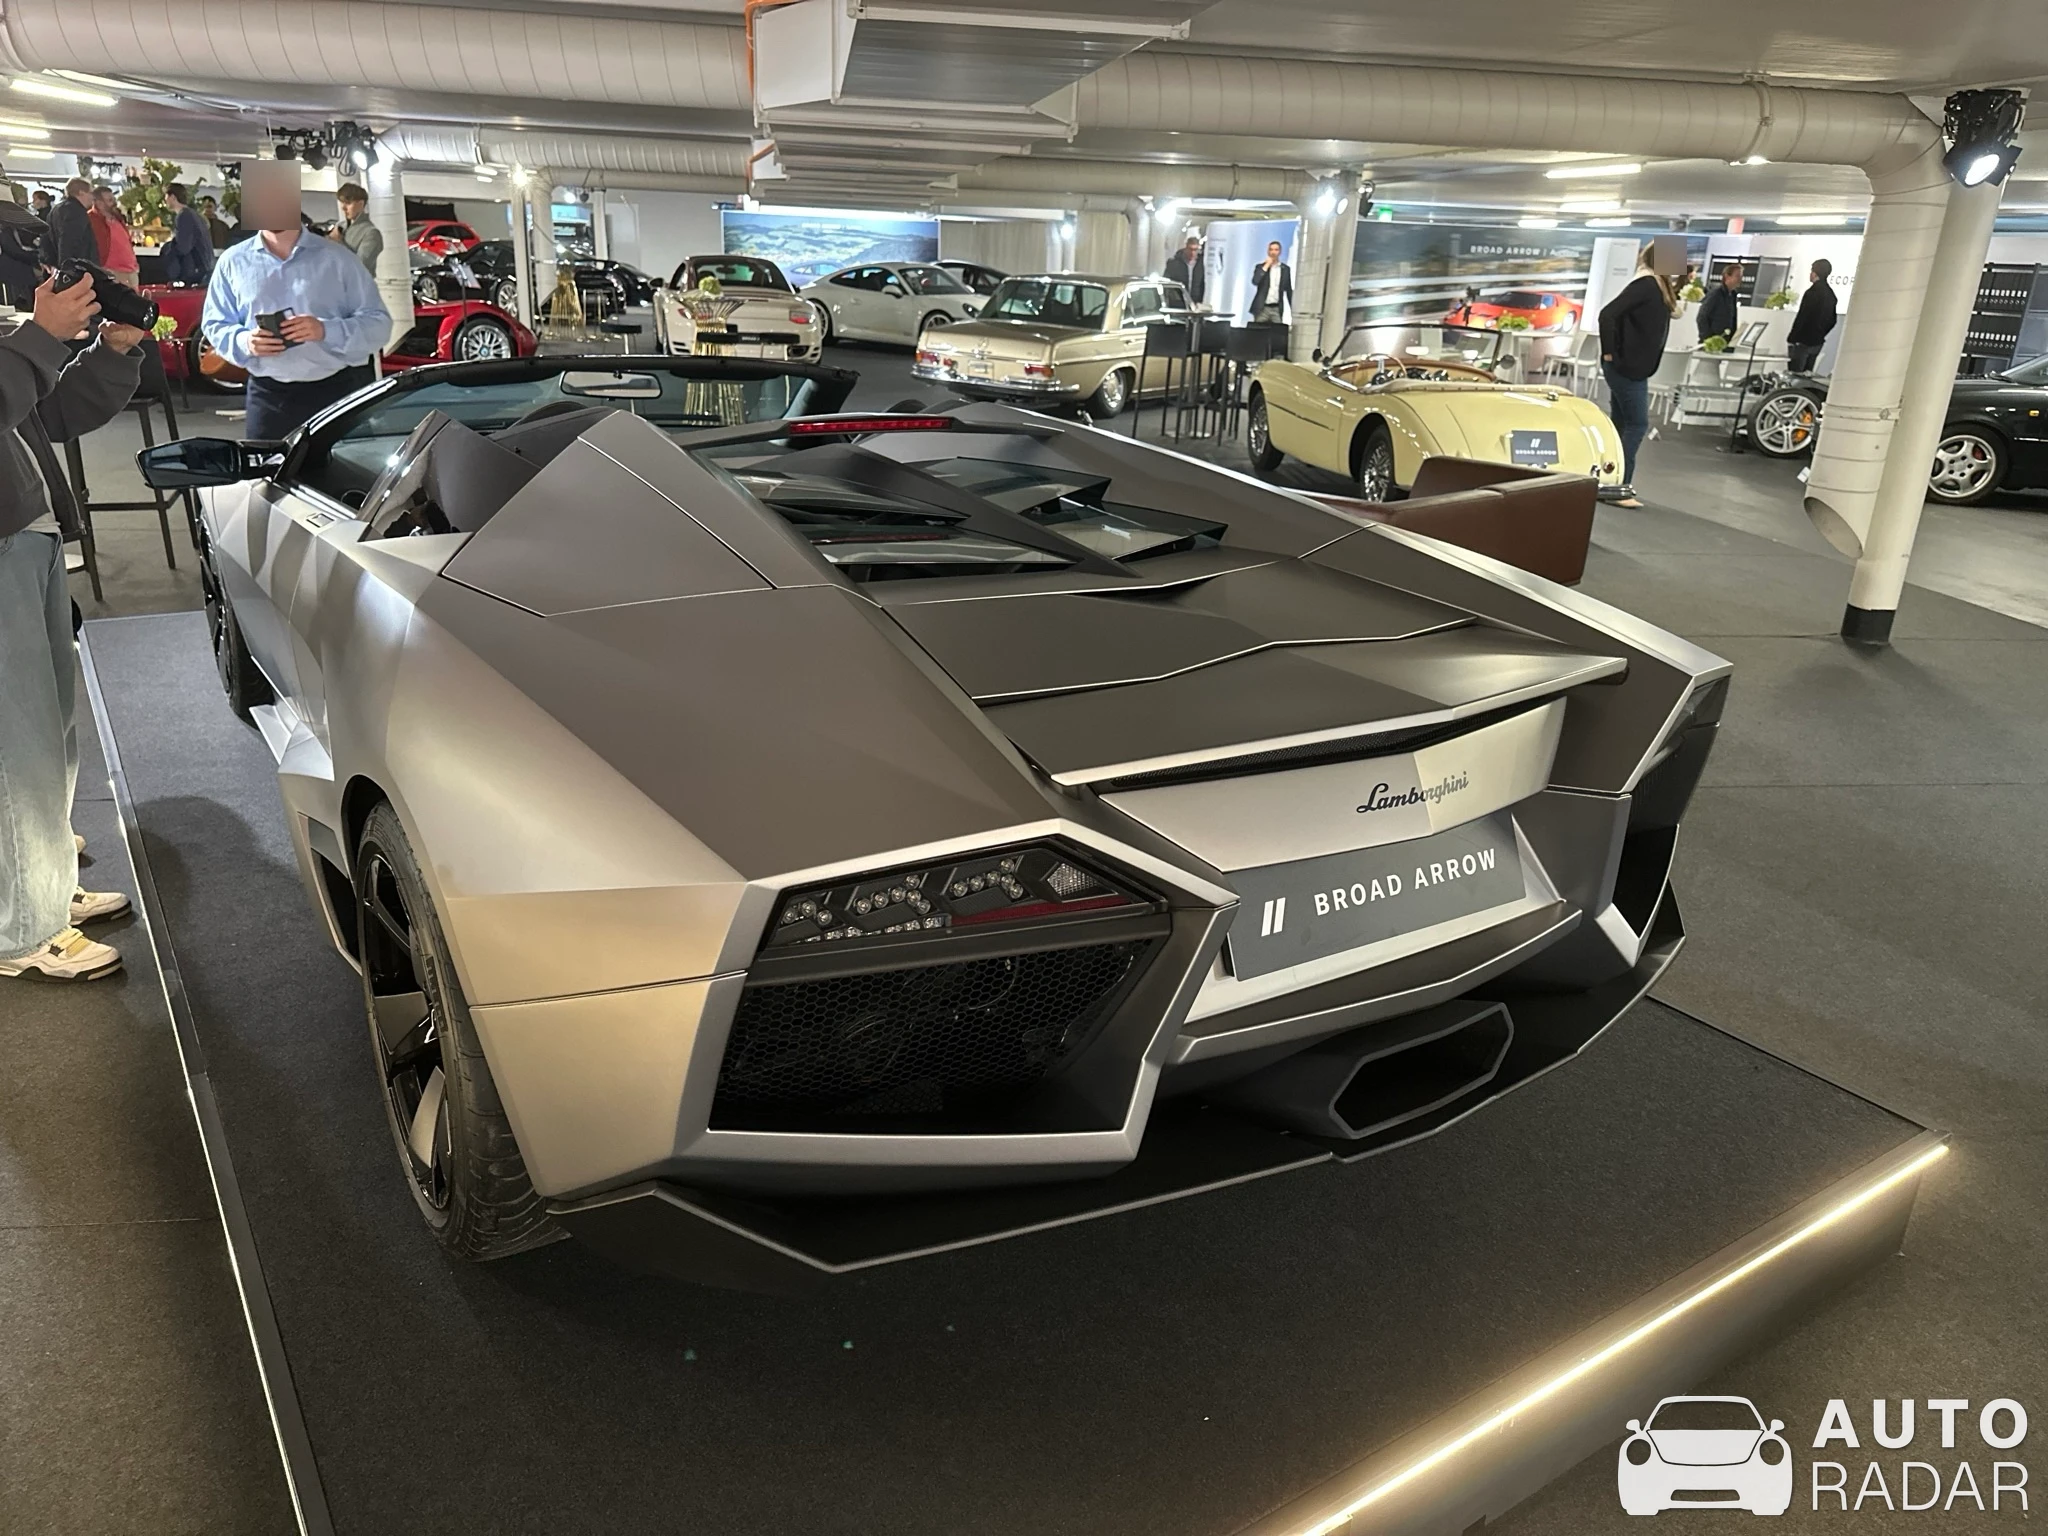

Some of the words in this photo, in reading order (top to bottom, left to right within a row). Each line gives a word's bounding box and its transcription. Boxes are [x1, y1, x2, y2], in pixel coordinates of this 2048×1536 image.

[1470, 245, 1503, 255] BROAD
[1505, 246, 1541, 256] ARROW
[1356, 770, 1469, 813] Lamborghini
[1313, 873, 1402, 916] BROAD
[1414, 848, 1496, 890] ARROW
